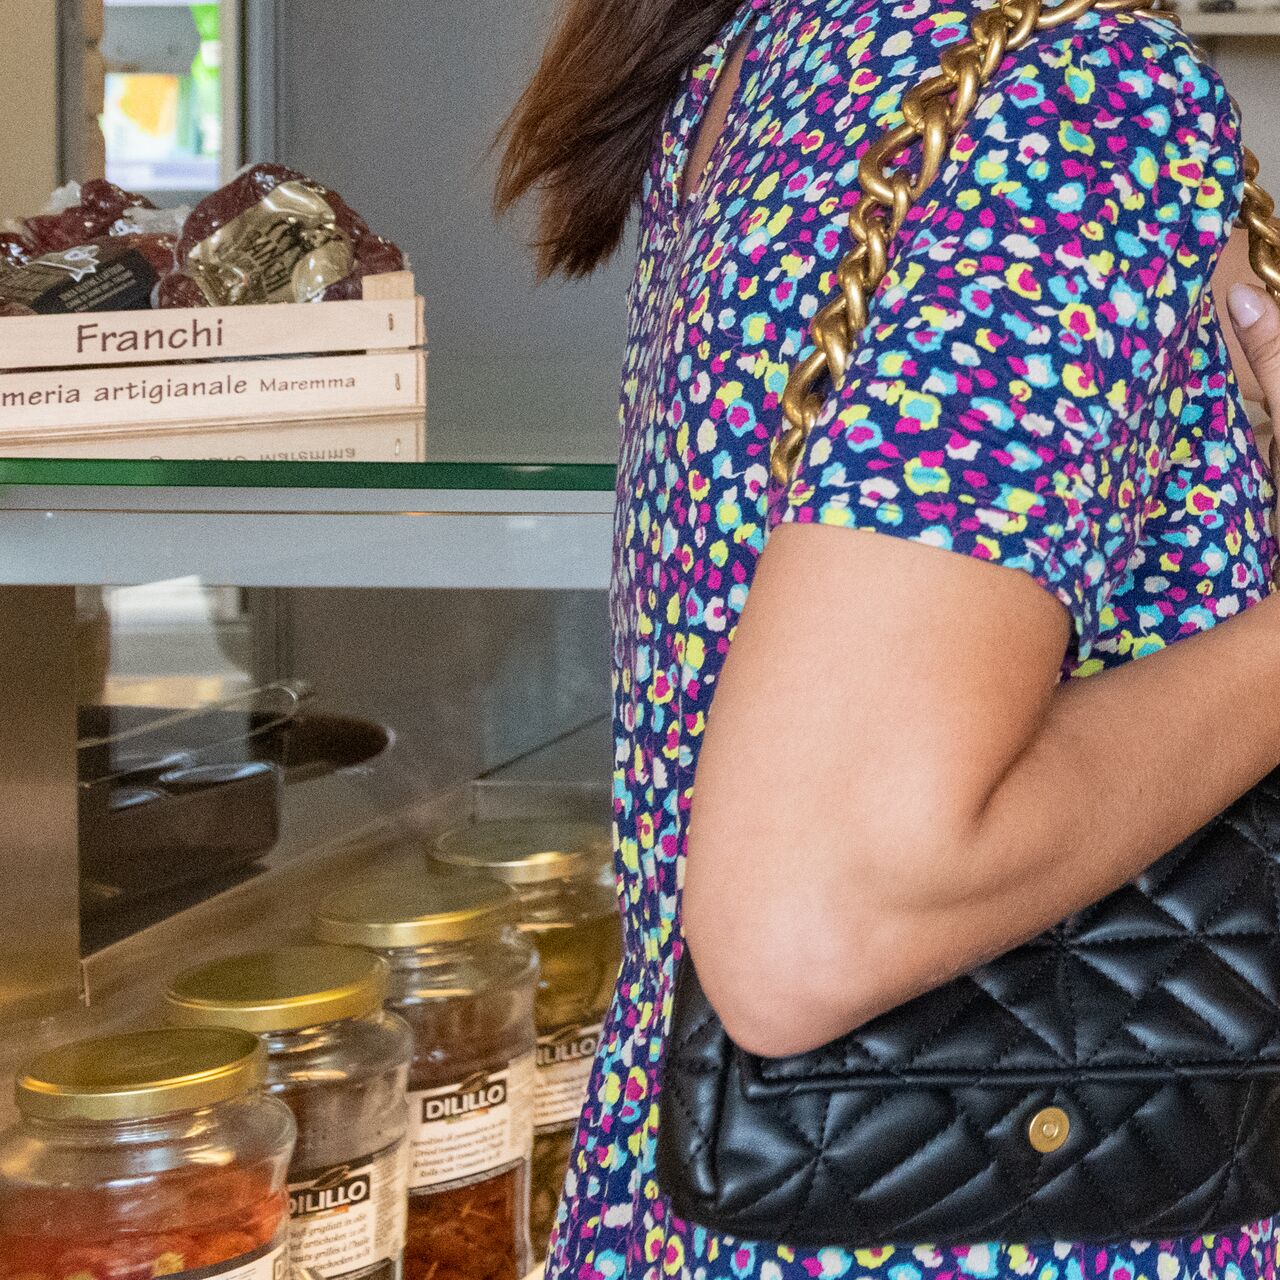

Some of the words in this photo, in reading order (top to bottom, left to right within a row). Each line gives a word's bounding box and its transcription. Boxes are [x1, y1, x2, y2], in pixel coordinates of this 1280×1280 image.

[76, 318, 224, 353] Franchi
[1, 383, 82, 407] meria
[93, 374, 248, 405] artigianale
[259, 376, 356, 393] Maremma
[536, 1037, 597, 1065] ILILLO
[425, 1084, 505, 1120] DILILLO
